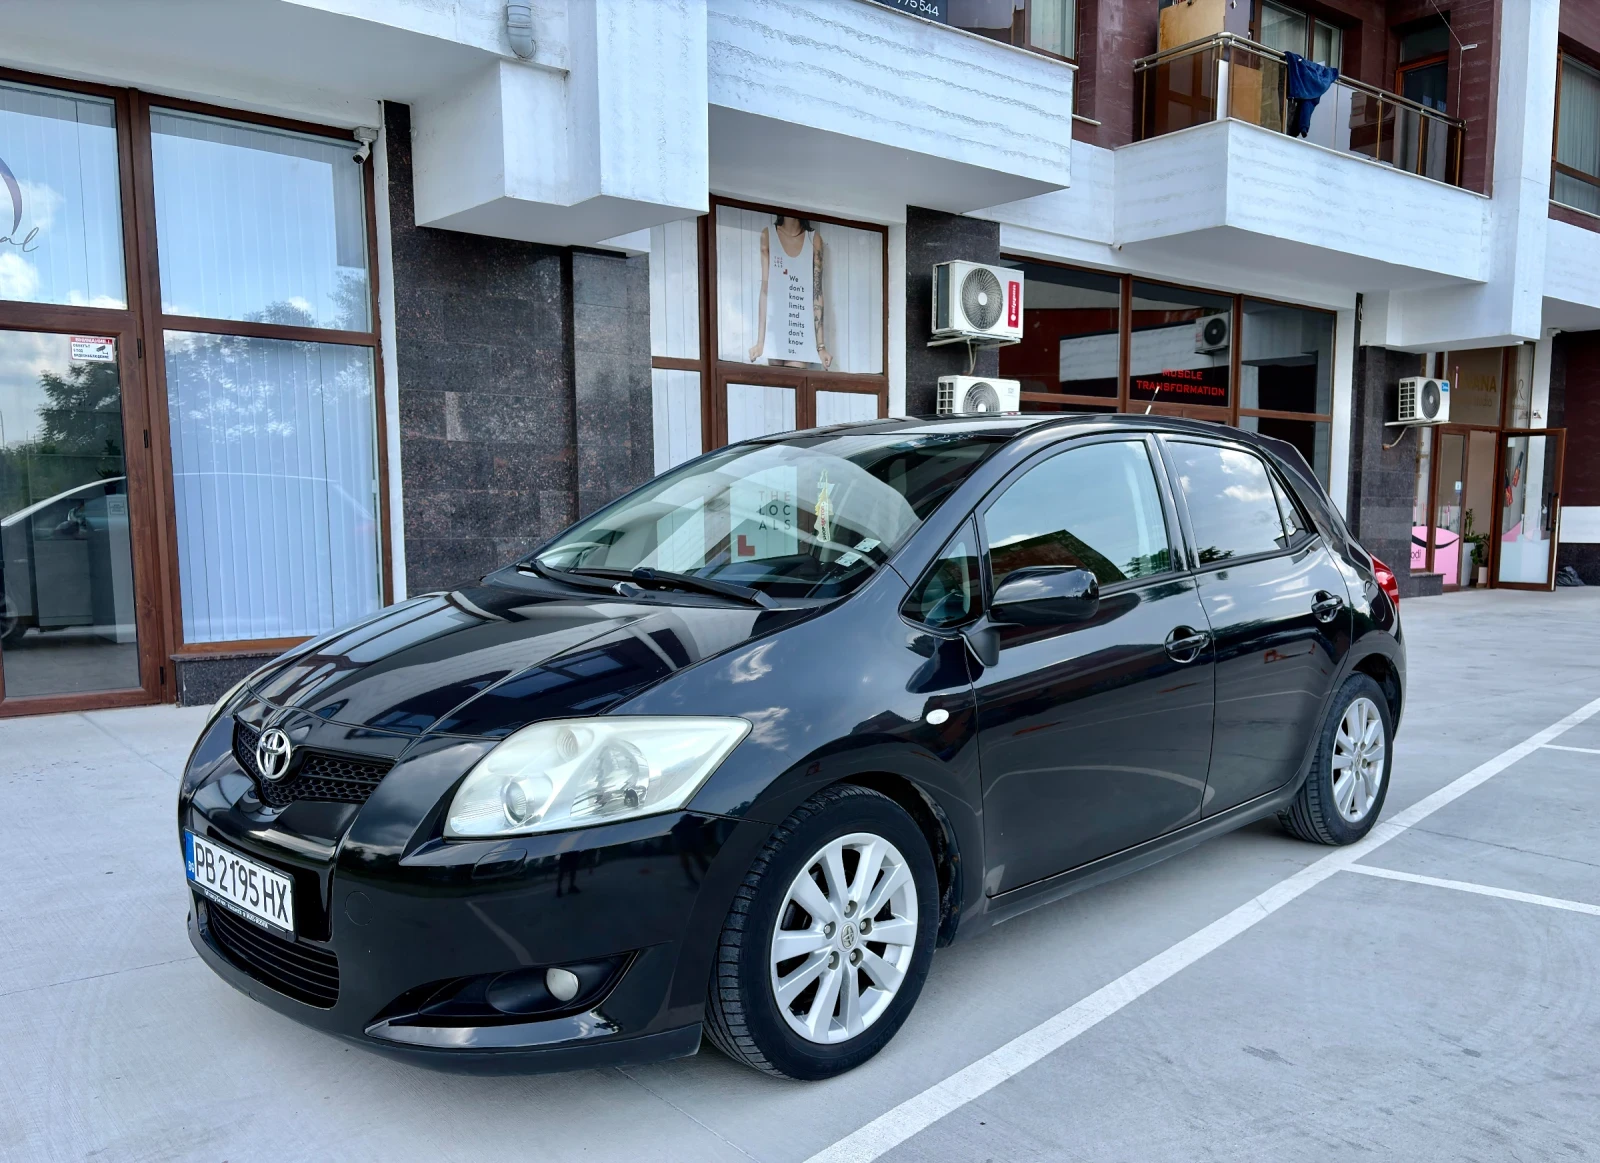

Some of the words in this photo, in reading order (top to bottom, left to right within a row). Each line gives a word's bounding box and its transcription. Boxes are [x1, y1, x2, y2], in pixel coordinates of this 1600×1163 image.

[919, 0, 940, 17] 544
[789, 284, 804, 292] don't
[788, 302, 805, 310] limits
[788, 319, 805, 328] limits
[788, 329, 804, 337] don't
[788, 338, 804, 346] know
[1162, 368, 1203, 380] MUSCLE
[1136, 379, 1225, 396] TRANSFORMATION
[218, 854, 260, 907] 2195
